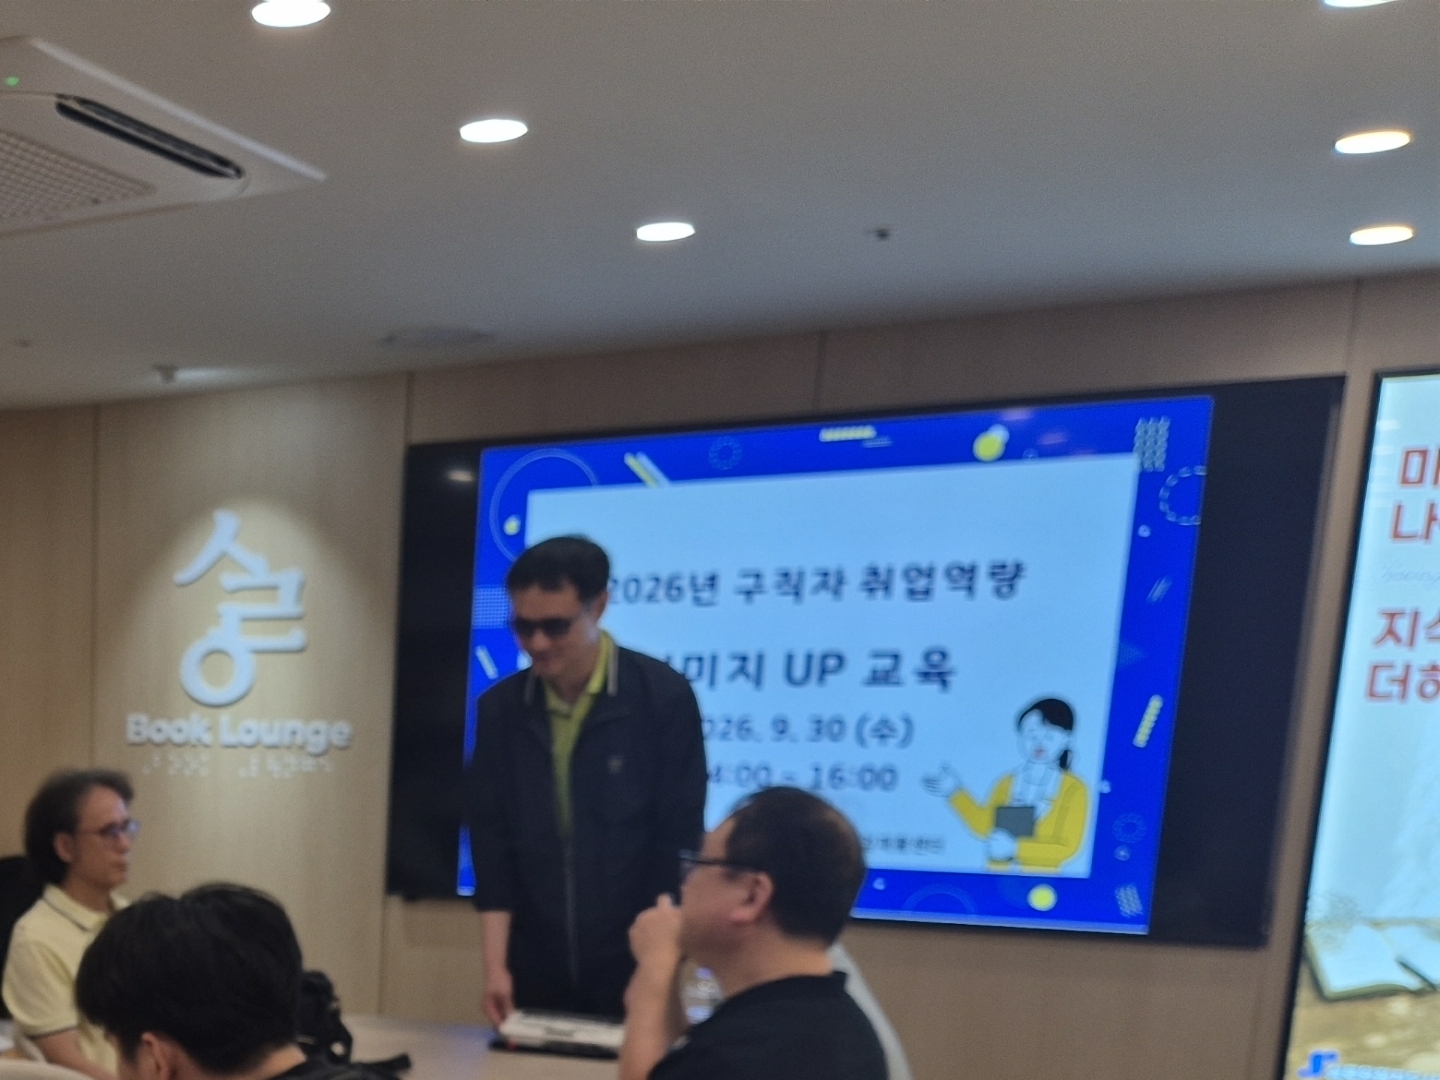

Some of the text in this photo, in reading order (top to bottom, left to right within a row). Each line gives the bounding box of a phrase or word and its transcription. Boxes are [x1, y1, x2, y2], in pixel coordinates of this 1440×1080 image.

[734, 565, 847, 605] 구직자
[859, 558, 1027, 602] 취업역량
[666, 646, 956, 695] 미지 UP 교육
[126, 713, 353, 757] Book Lounge
[807, 712, 847, 743] 30
[811, 761, 899, 792] 16:00
